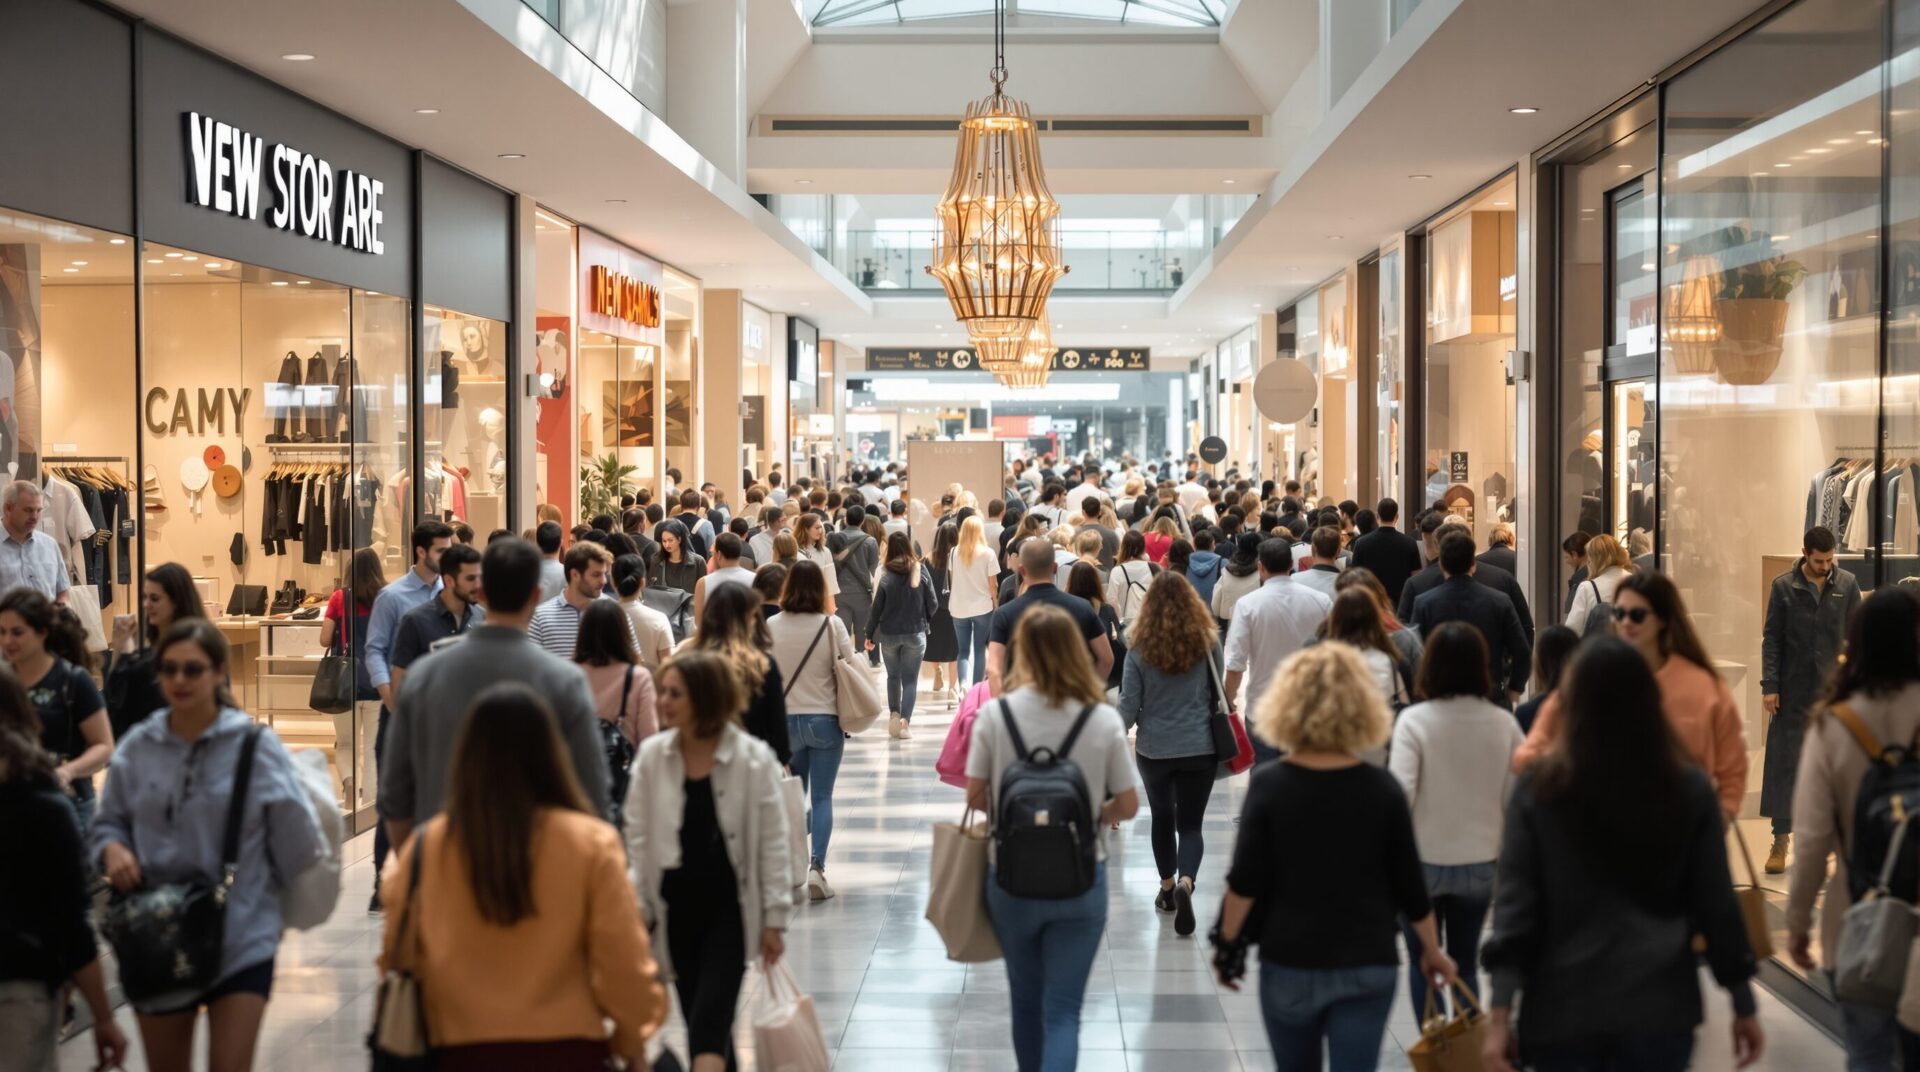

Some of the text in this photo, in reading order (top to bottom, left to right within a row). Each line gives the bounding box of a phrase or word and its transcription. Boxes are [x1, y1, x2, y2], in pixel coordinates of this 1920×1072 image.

[270, 143, 334, 241] STOR
[340, 169, 384, 255] ARE
[145, 386, 252, 437] CAMY
